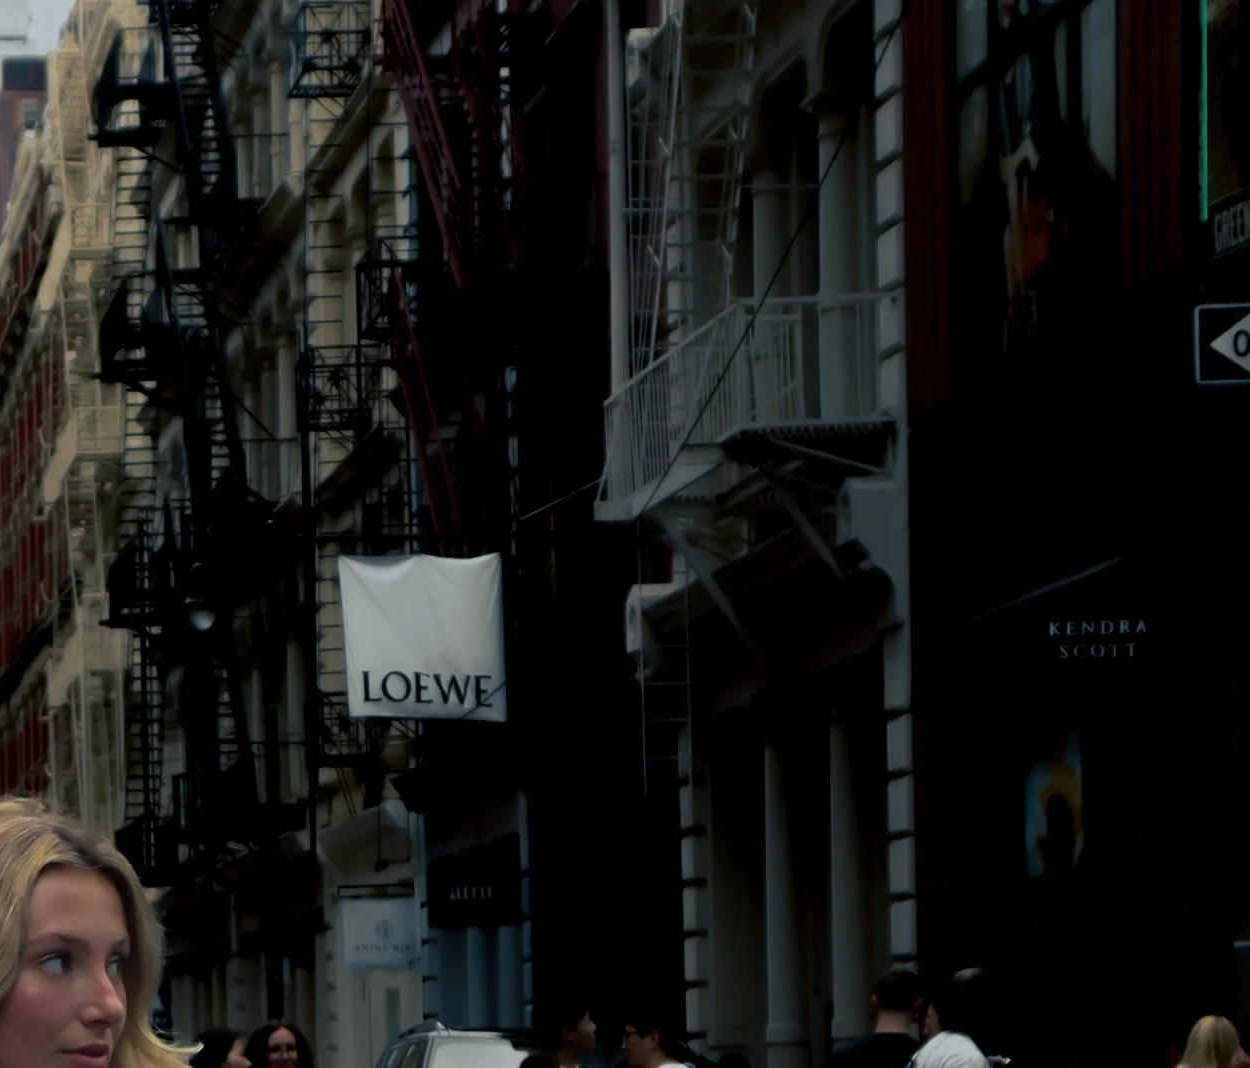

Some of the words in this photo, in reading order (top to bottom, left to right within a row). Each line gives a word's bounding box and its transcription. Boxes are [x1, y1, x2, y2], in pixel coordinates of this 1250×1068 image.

[1049, 619, 1147, 636] KENDRA
[1059, 643, 1138, 659] SCOTT
[362, 671, 493, 707] LOEWE
